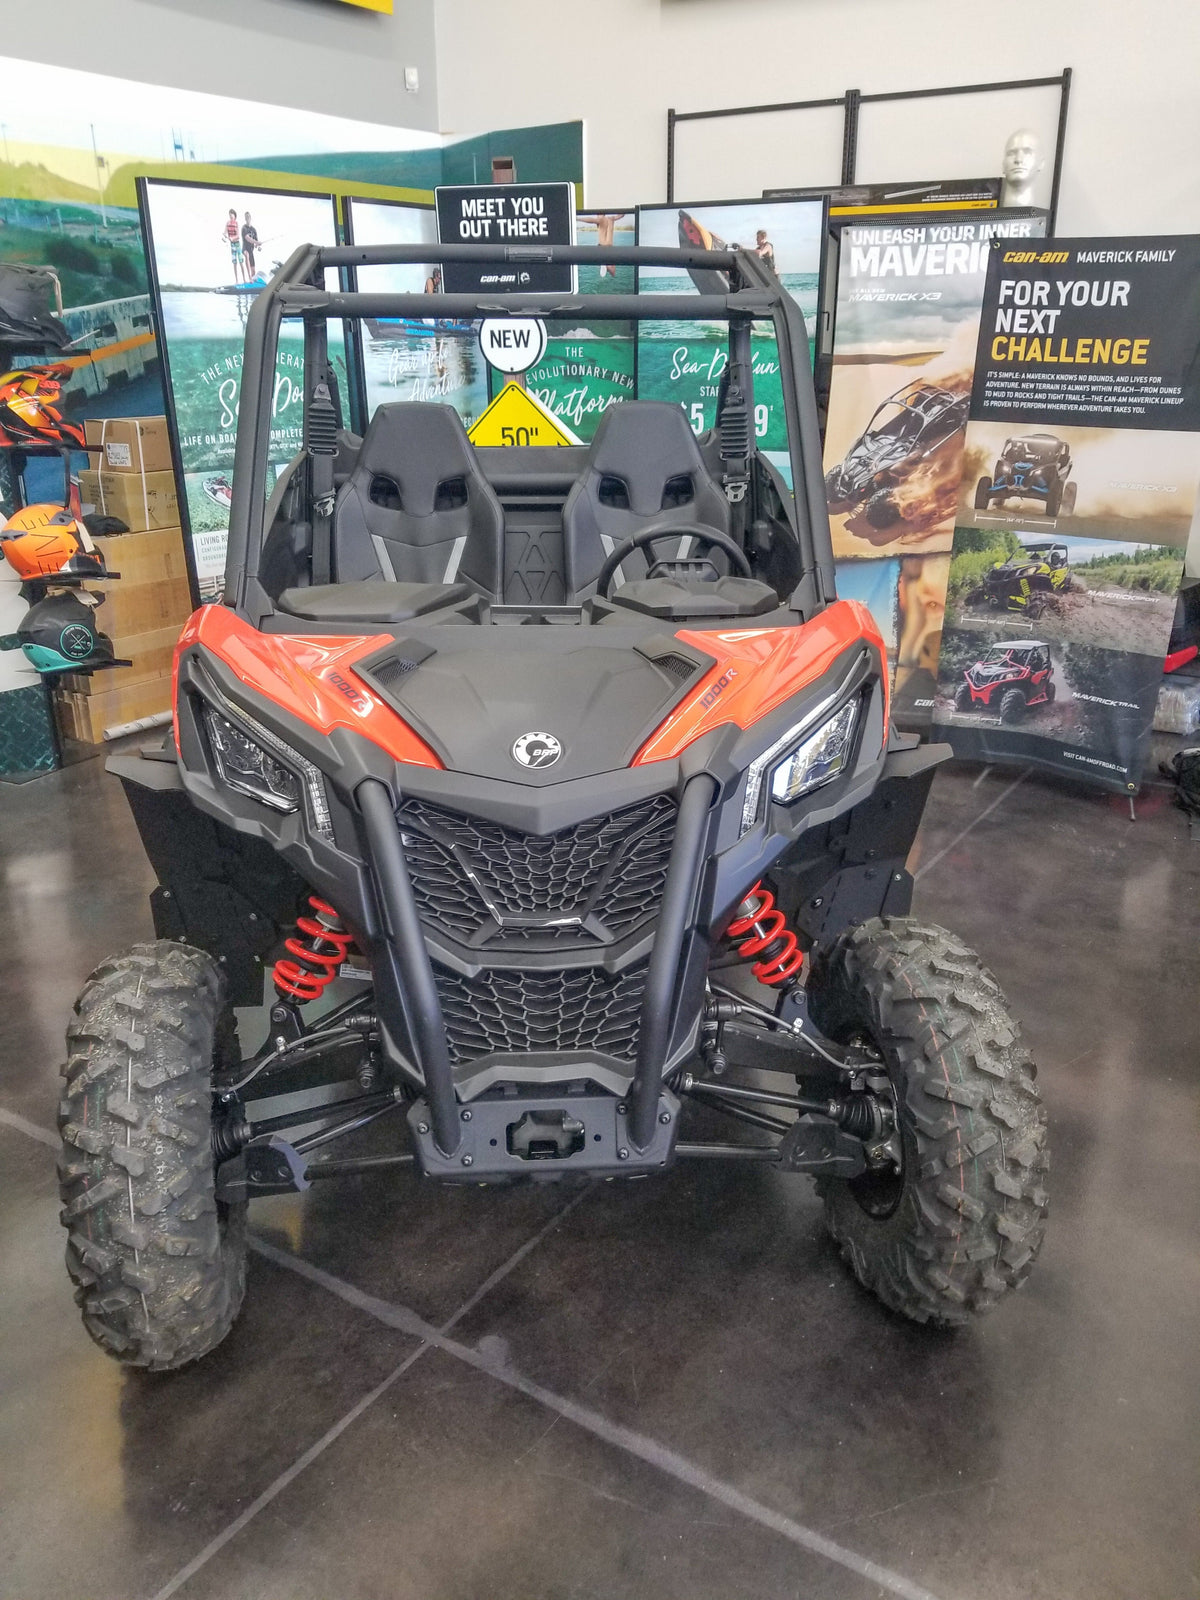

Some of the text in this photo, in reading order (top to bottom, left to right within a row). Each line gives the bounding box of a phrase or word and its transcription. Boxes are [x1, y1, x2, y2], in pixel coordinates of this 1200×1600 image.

[461, 197, 544, 217] MEET YOU
[460, 217, 548, 238] OUT THERE
[852, 223, 1032, 245] UNLEASH YOUR INNER
[850, 242, 990, 277] MAVERI
[1003, 250, 1176, 263] can-am MAVERICK FAMILY
[480, 274, 516, 283] can-am
[849, 292, 942, 303] MAVERICK X3
[998, 280, 1130, 307] FOR YOUR
[995, 308, 1061, 334] NEXT
[489, 329, 531, 349] NEW
[565, 346, 584, 358] THE
[991, 336, 1150, 365] CHALLENGE
[200, 362, 222, 385] THE
[224, 353, 244, 370] NEX
[670, 346, 729, 381] Sea-D
[526, 364, 635, 390] EVOLUTIONARY NEW
[987, 370, 998, 378] IT'S
[1021, 372, 1026, 380] A
[1026, 373, 1055, 381] MAVERICK
[1056, 374, 1078, 382] KNOWS
[1078, 374, 1087, 382] NO
[1088, 375, 1115, 383] BOUNDS,
[1116, 375, 1129, 383] AND
[1130, 376, 1148, 384] LIVES
[1149, 376, 1162, 384] FOR
[985, 381, 1020, 389] ADVENTURE.
[1021, 382, 1034, 390] NEW
[1035, 382, 1060, 390] TERRAIN
[1061, 383, 1067, 391] IS
[1067, 384, 1090, 392] ALWAYS
[993, 390, 1006, 398] MUD
[1014, 391, 1033, 399] ROCKS
[1104, 395, 1127, 403] CAN-AM
[1128, 396, 1159, 404] MAVERICK
[1160, 397, 1184, 405] LINEUP
[990, 400, 1012, 408] PROVEN
[1012, 401, 1019, 409] TO
[1020, 402, 1046, 410] PERFORM
[1047, 403, 1078, 411] WHEREVER
[1078, 404, 1112, 413] ADVENTURE
[1113, 405, 1132, 413] TAKES
[1132, 406, 1146, 414] YOU.
[183, 428, 303, 446] LIFE ON BOA OMPLETE
[501, 427, 539, 446] 50"
[200, 535, 220, 545] LIVING
[1087, 590, 1137, 601] MAVERICK
[700, 668, 739, 709] 1000R
[1071, 691, 1140, 709] MAVERICK TRAIL
[1063, 751, 1075, 759] VISIT
